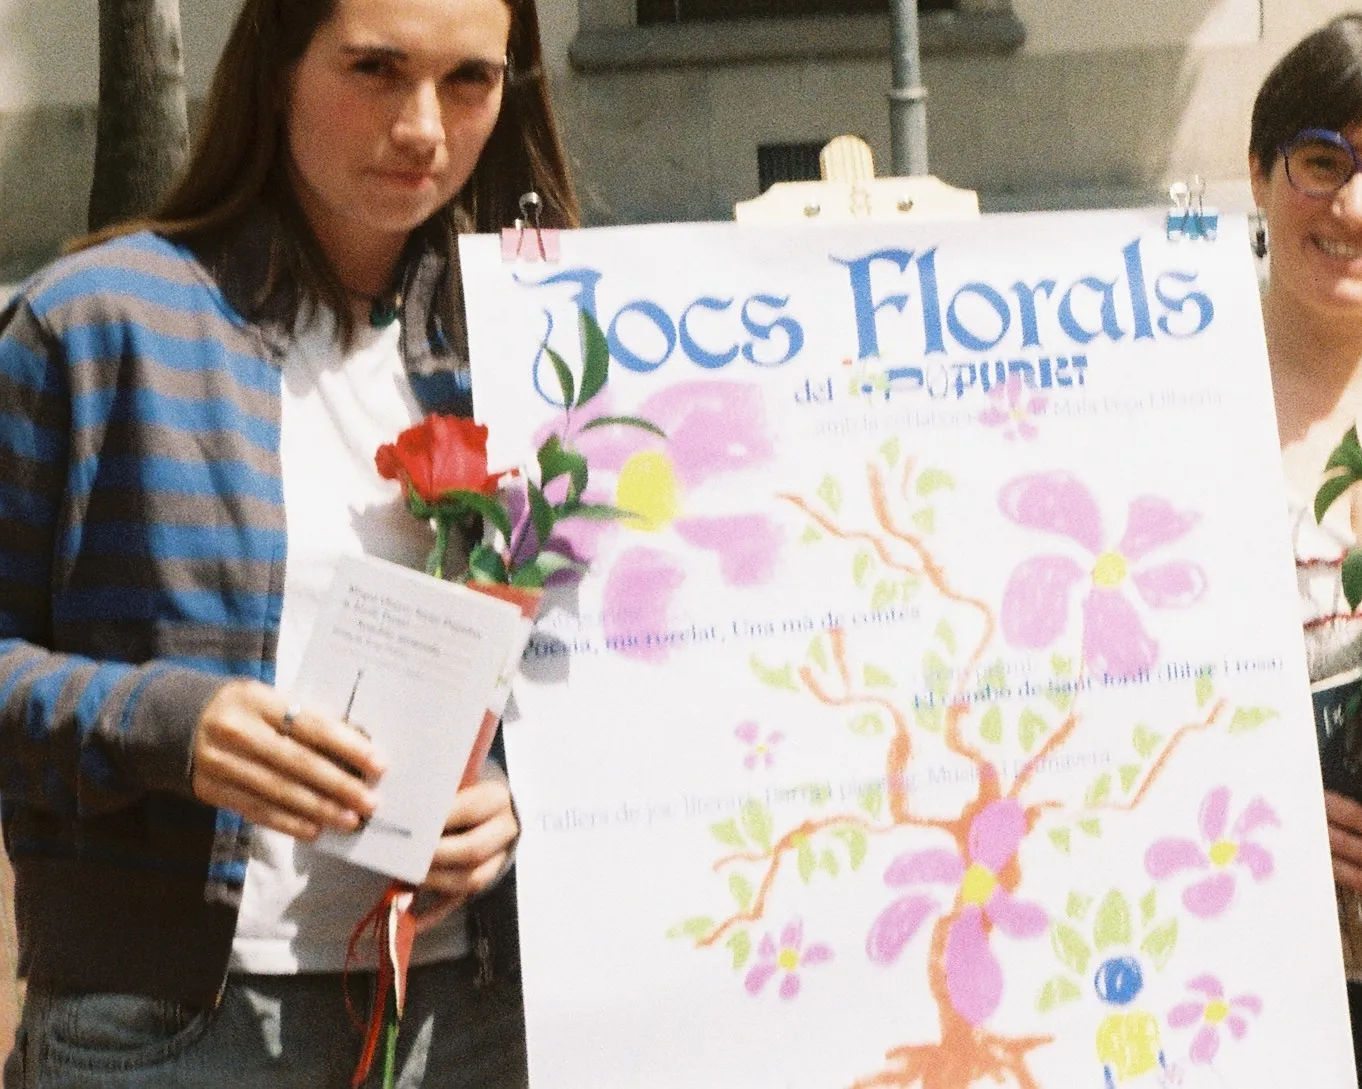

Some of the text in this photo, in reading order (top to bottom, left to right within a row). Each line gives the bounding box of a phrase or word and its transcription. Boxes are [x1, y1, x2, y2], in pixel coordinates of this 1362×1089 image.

[511, 237, 1216, 411] Jocs Florals
[793, 377, 835, 405] del
